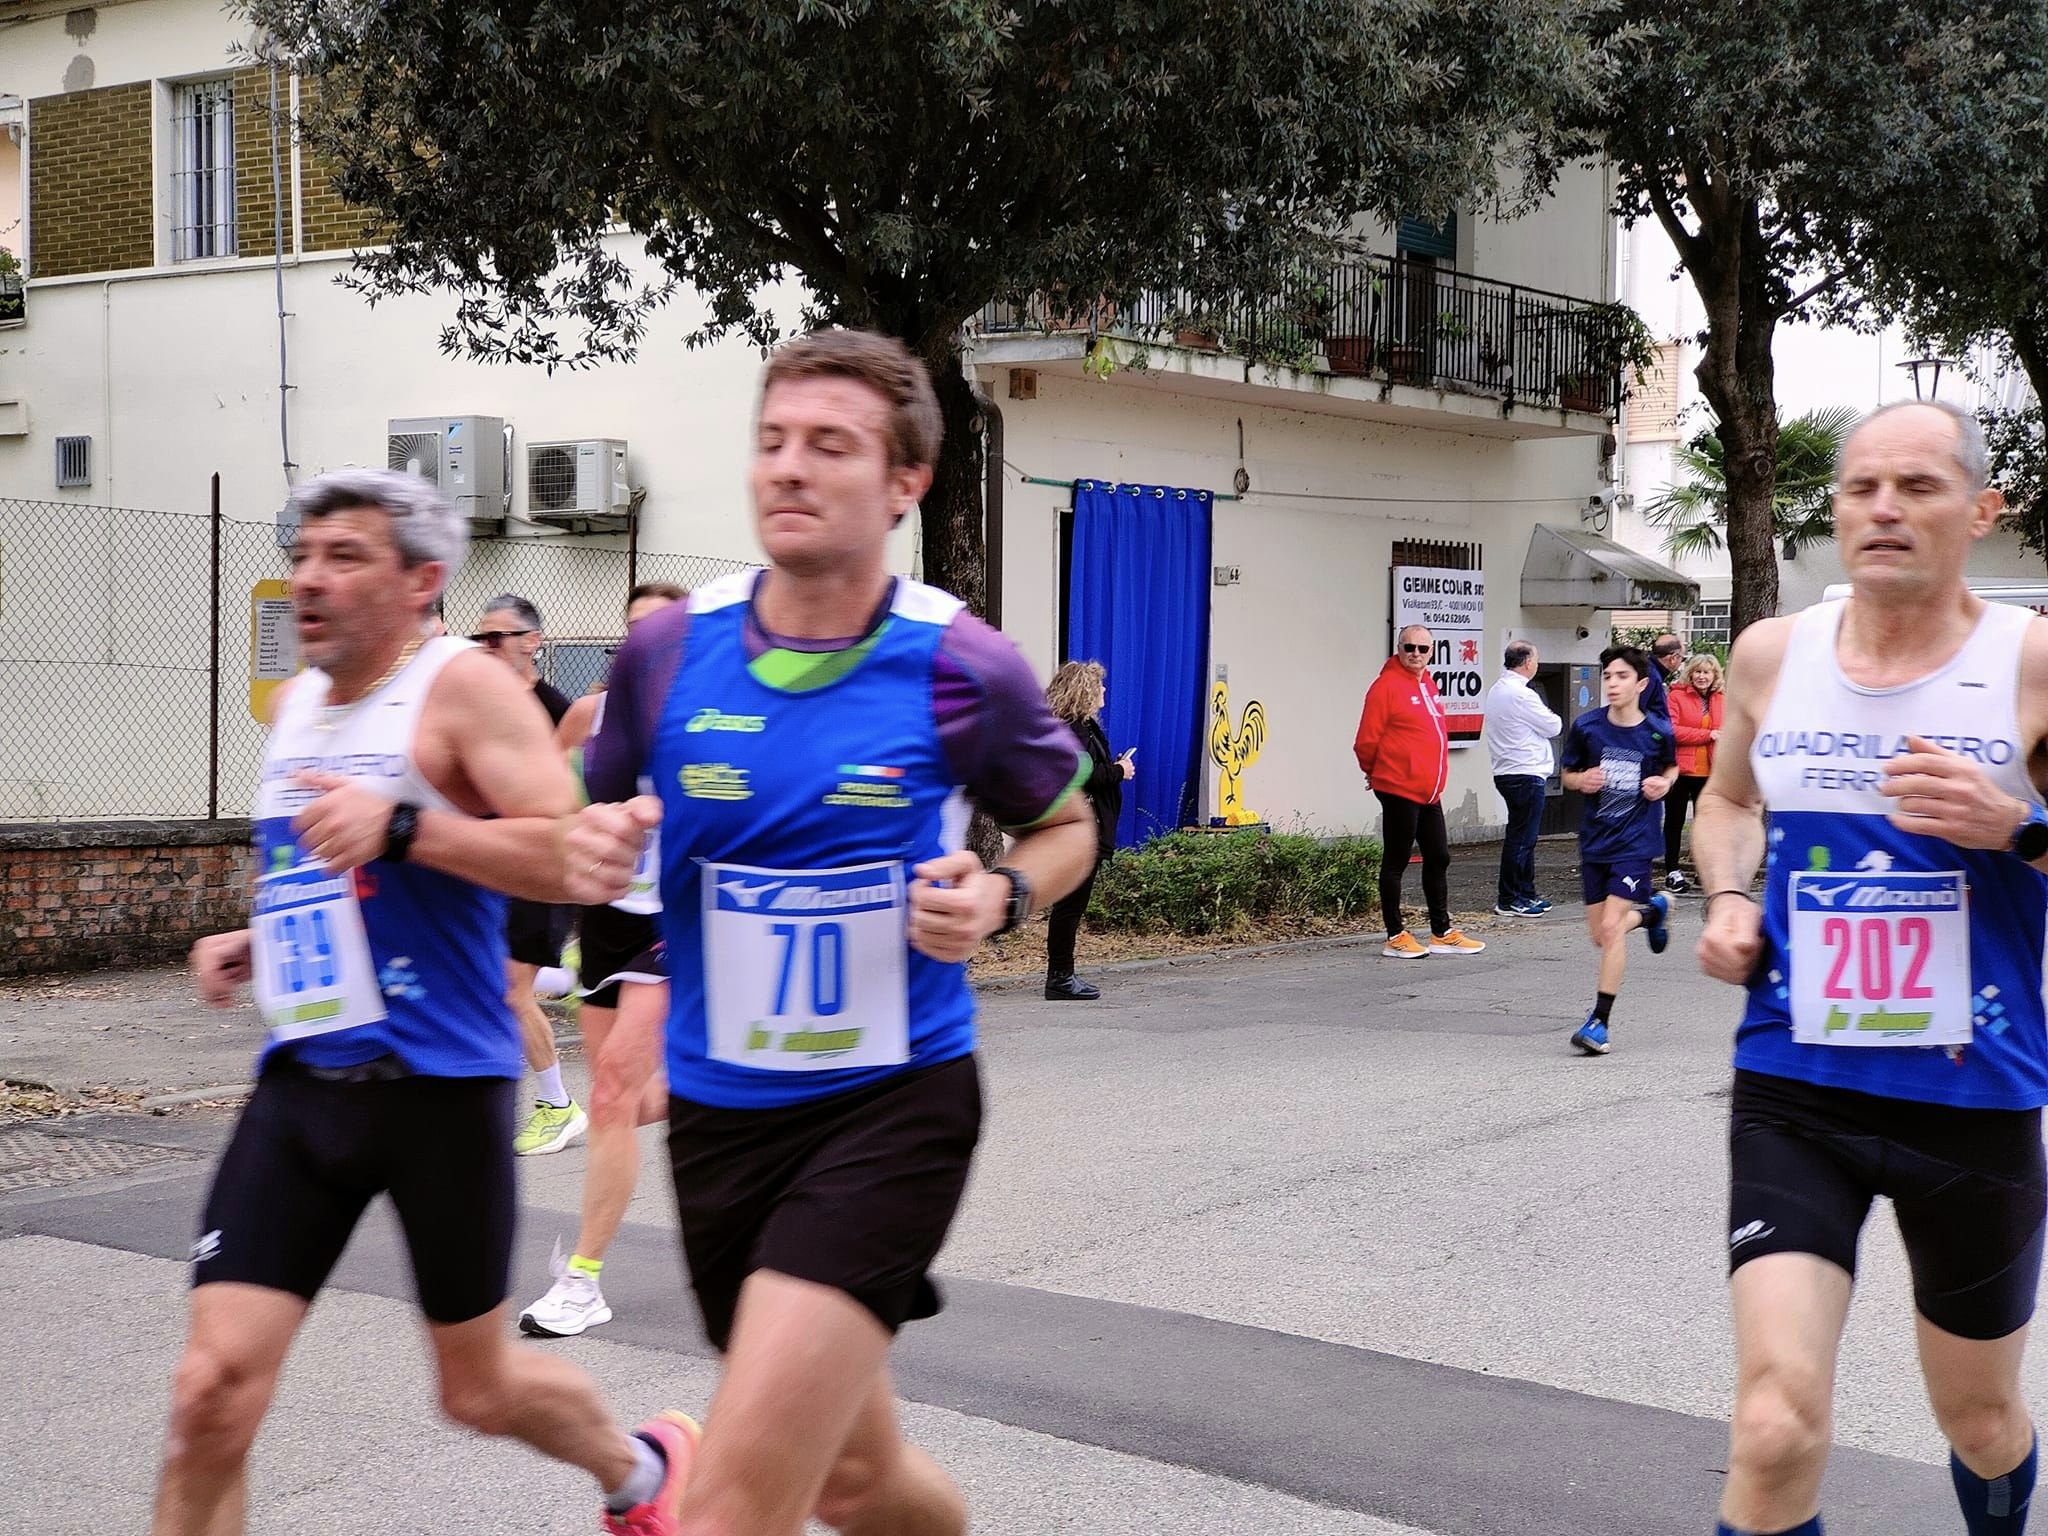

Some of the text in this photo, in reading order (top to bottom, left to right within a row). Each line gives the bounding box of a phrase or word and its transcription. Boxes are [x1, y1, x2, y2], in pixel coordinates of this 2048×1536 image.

[1432, 671, 1482, 697] arco
[1758, 731, 2014, 765] QUADRILAERO
[1801, 767, 1883, 791] FERR
[769, 922, 843, 1016] 70
[1823, 917, 1934, 1001] 202
